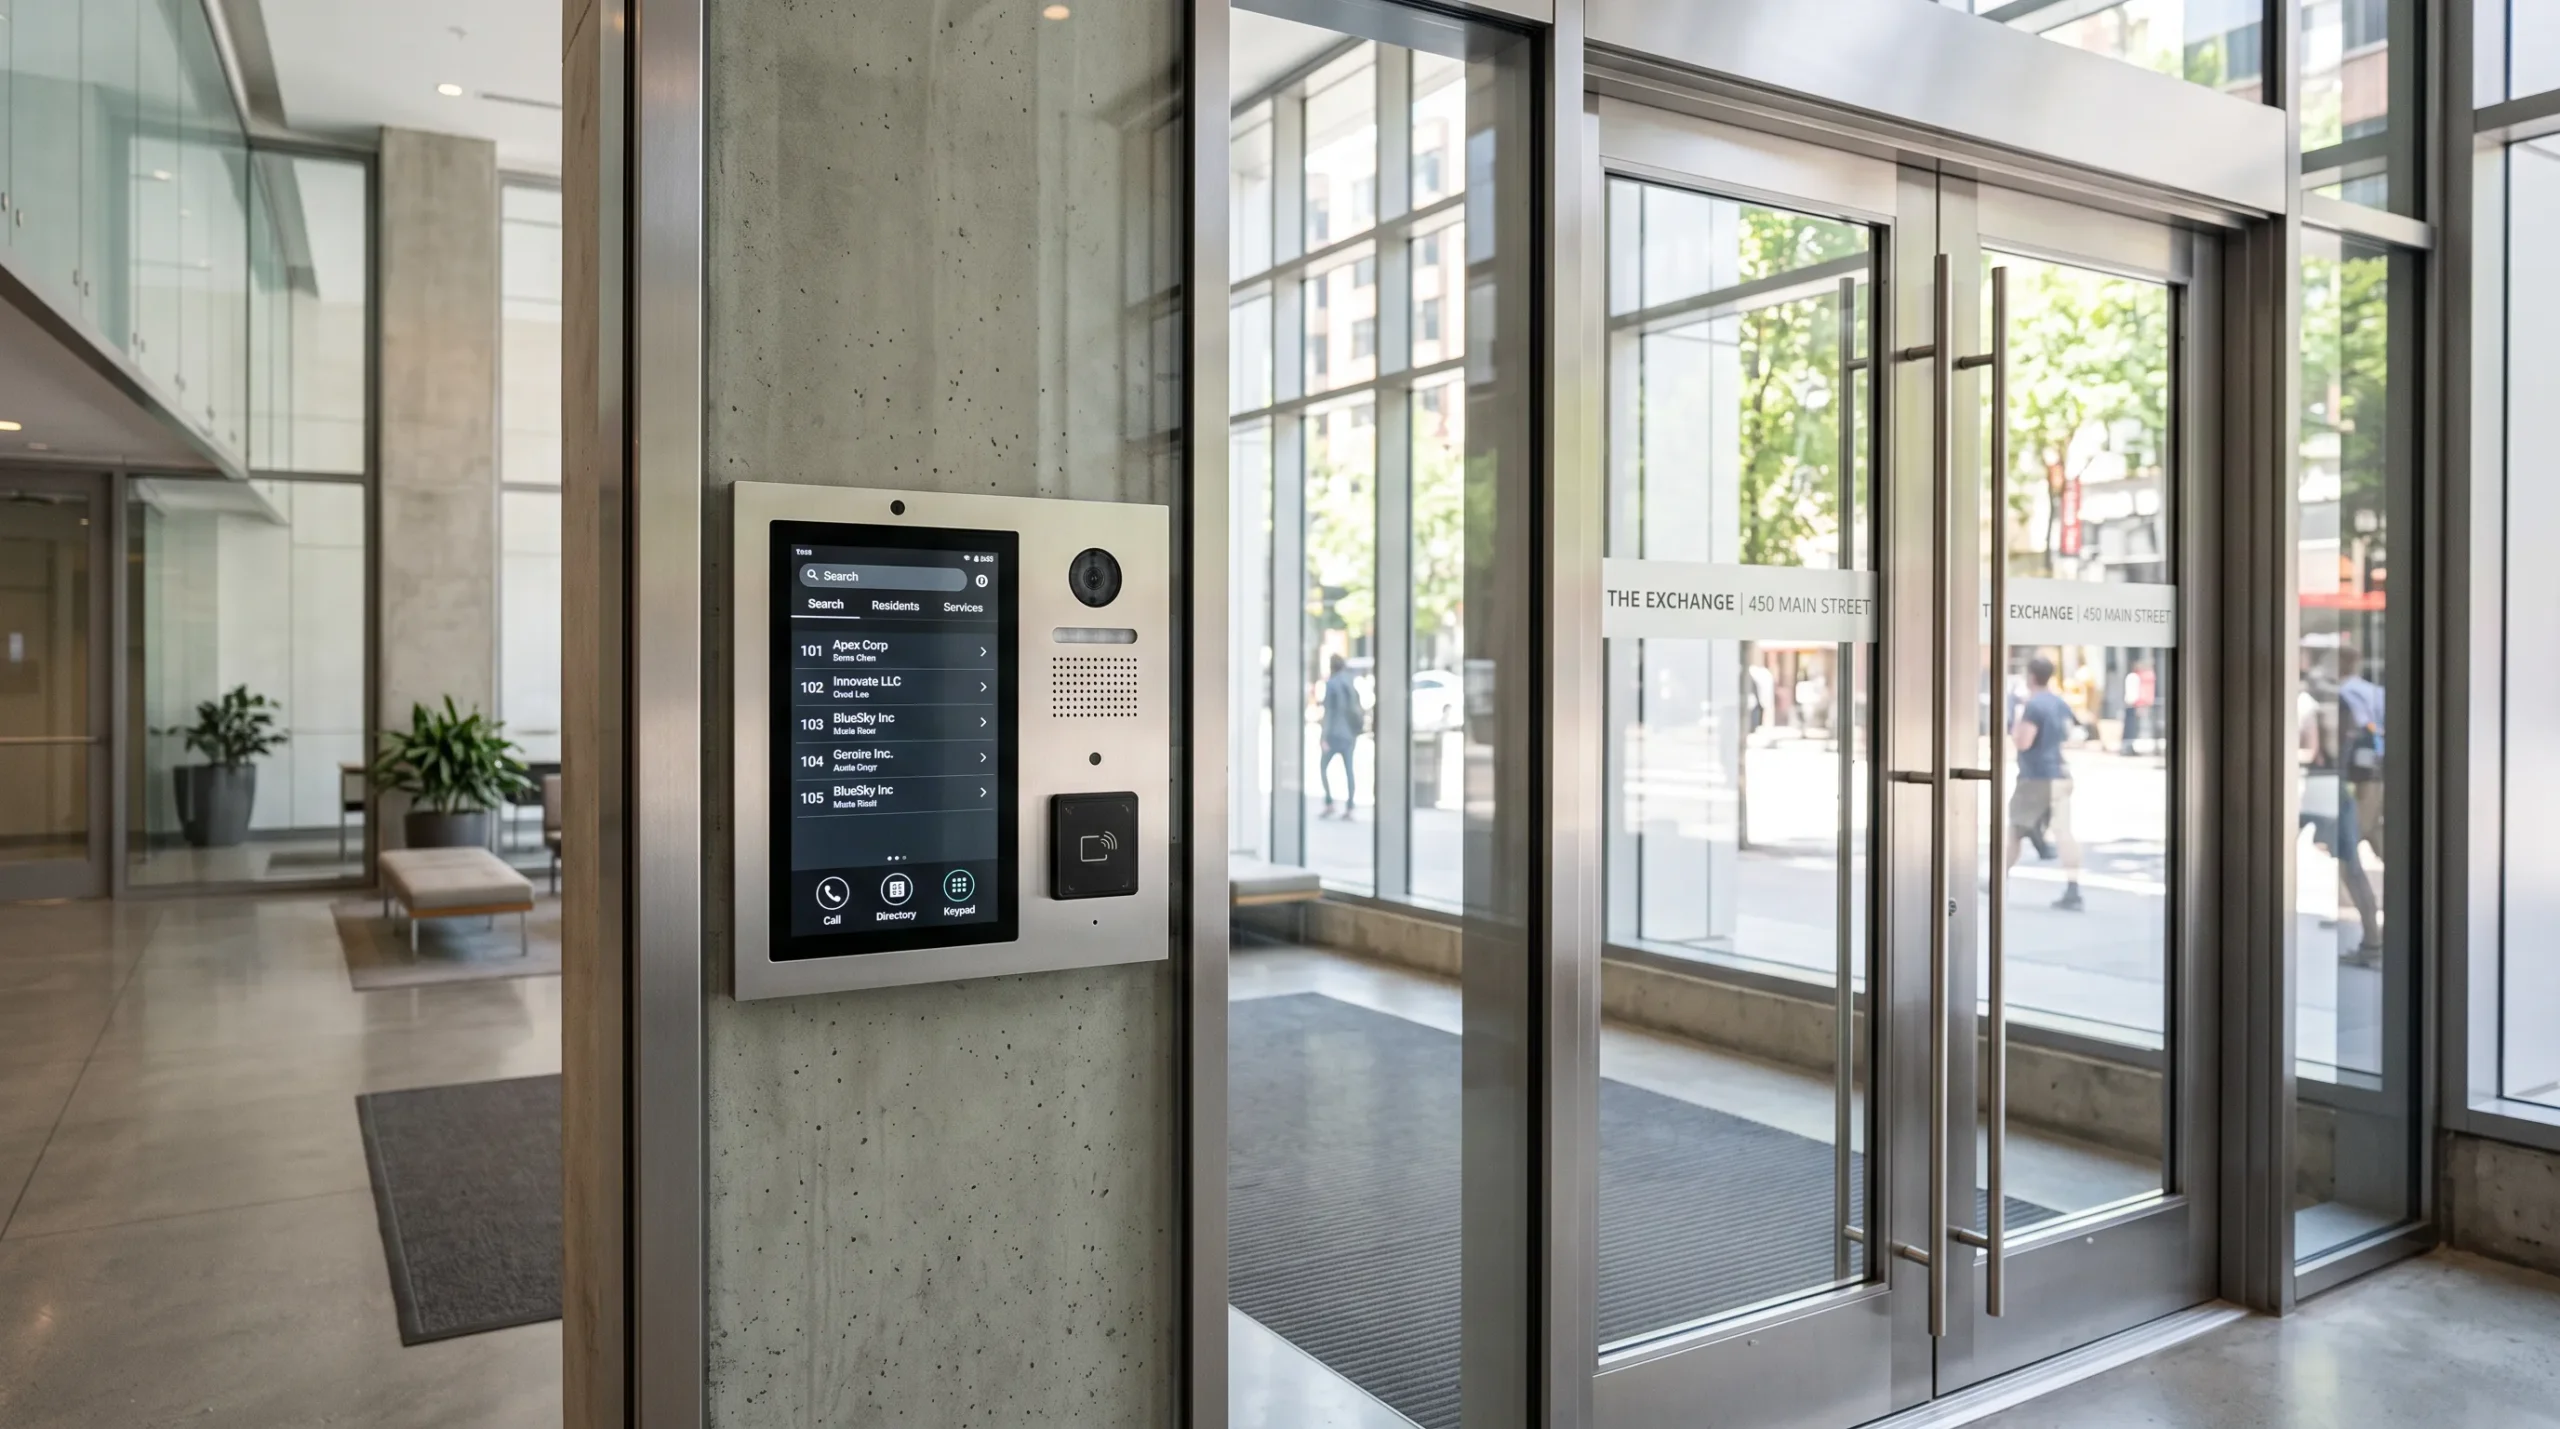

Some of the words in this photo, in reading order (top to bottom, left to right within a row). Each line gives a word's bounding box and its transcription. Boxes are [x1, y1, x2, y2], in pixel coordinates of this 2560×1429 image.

[823, 570, 859, 582] Search
[807, 598, 844, 610] Search
[871, 600, 920, 612] Residents
[943, 602, 984, 613] Services
[1607, 589, 1640, 608] THE
[1645, 591, 1734, 611] EXCHANGE
[1748, 595, 1775, 612] 450
[1779, 596, 1817, 614] MAIN
[1820, 598, 1871, 616] STREET
[2009, 604, 2073, 621] EXCHANGE
[2083, 607, 2102, 622] 450
[2104, 608, 2132, 623] MAIN
[2134, 609, 2172, 624] STREET
[800, 645, 823, 657] 101
[832, 640, 860, 652] Apex
[862, 640, 889, 653] Corp
[833, 676, 879, 687] Innovate
[880, 676, 902, 687] LLC
[800, 682, 825, 694] 102
[855, 691, 870, 699] Lee
[800, 719, 825, 731] 103
[833, 713, 876, 726] BlueSky
[878, 713, 895, 724] Inc
[873, 749, 894, 759] Inc.
[800, 756, 825, 768] 104
[833, 786, 876, 798] BlueSky
[877, 785, 894, 795] Inc
[800, 792, 825, 805] 105
[876, 911, 917, 922] Directory
[943, 905, 976, 917] Keypad
[823, 915, 842, 926] Call
